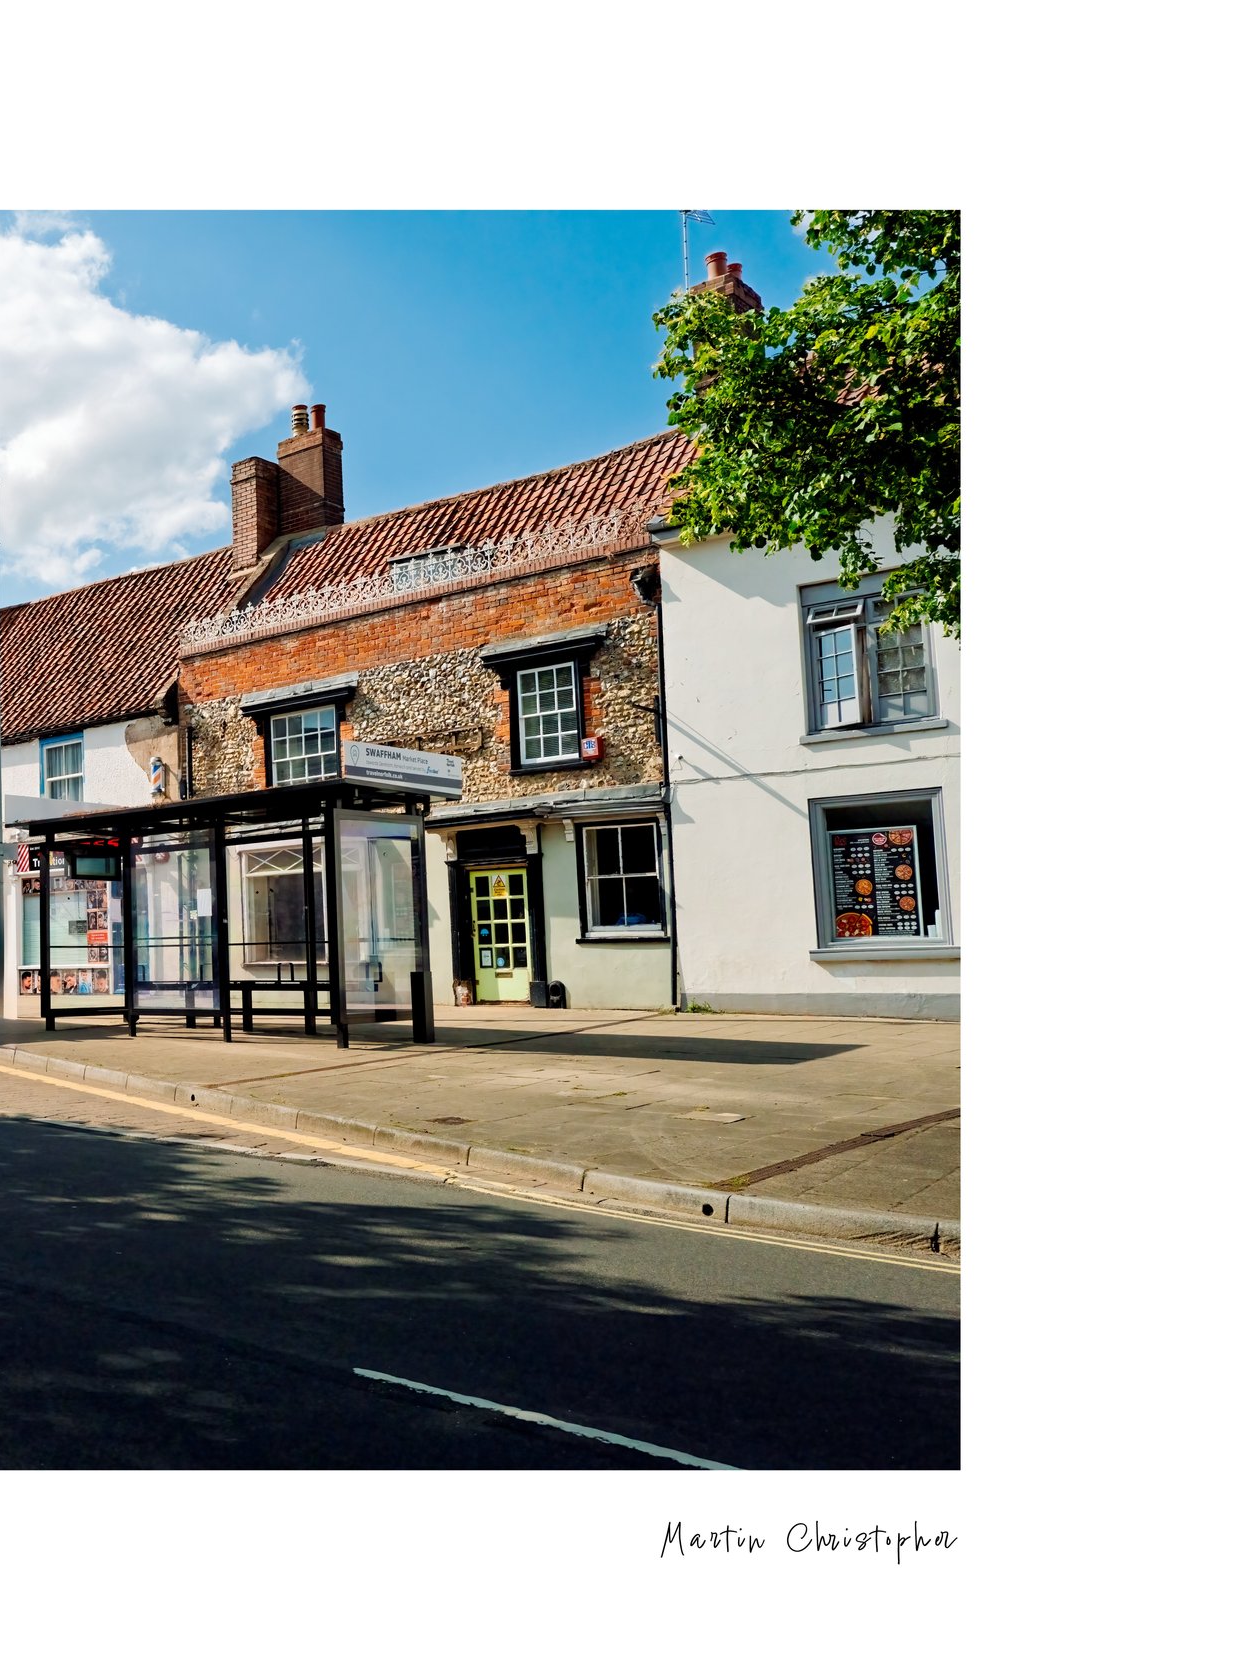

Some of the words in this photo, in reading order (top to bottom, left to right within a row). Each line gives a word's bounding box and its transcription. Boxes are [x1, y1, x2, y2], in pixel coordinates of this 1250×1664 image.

[366, 748, 401, 760] SWAFFHAM
[402, 755, 417, 763] Market
[417, 757, 429, 765] Place
